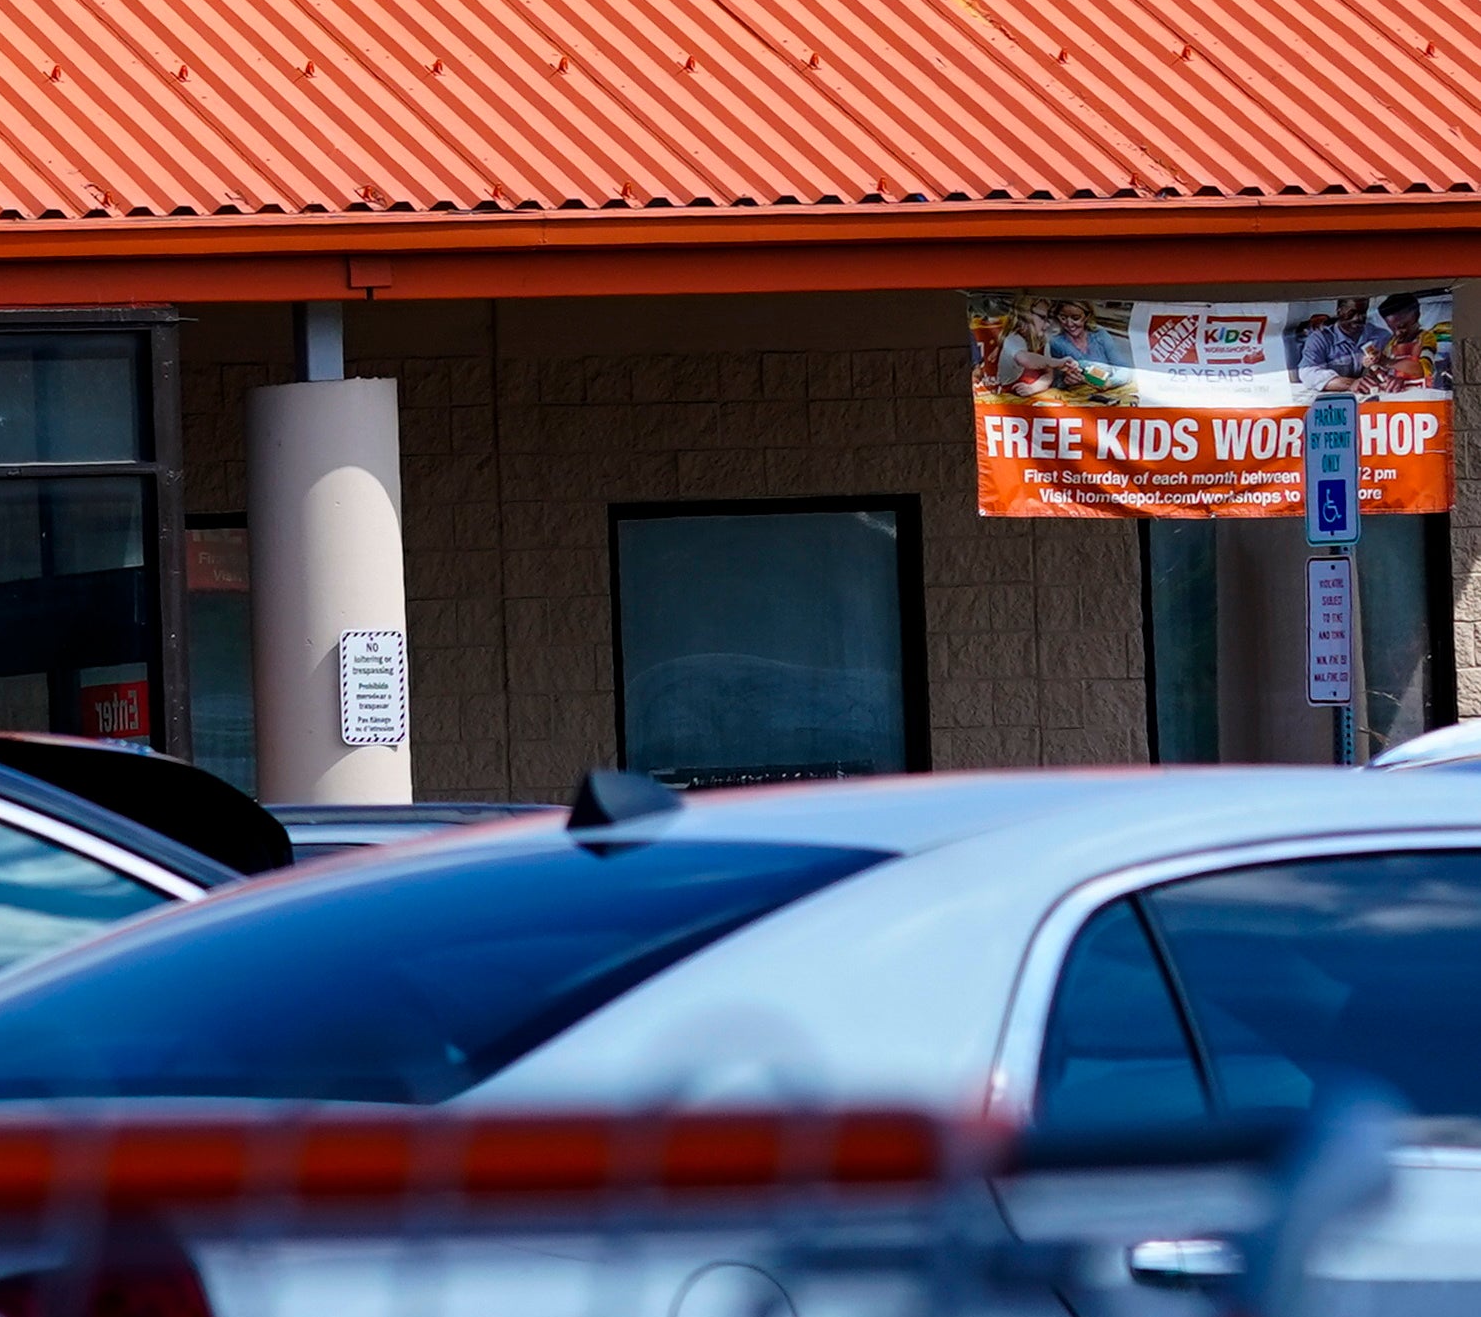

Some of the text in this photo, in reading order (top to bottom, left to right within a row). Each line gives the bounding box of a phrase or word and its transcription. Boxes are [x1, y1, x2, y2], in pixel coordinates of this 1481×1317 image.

[1150, 314, 1199, 363] HOME
[1152, 318, 1176, 340] THE
[1204, 327, 1254, 345] KIDS
[1169, 335, 1198, 364] DEPOT
[1167, 367, 1255, 383] 25 YEARS
[1314, 407, 1348, 427] PARKING
[984, 412, 1439, 462] FREE KIDS WORHOP
[1310, 431, 1351, 450] BY PERMIT
[1321, 454, 1341, 473] ONLY
[1023, 469, 1058, 484] First
[1062, 470, 1130, 488] Saturday
[1133, 471, 1151, 485] of
[1152, 470, 1187, 485] each
[1191, 470, 1238, 485] month
[1240, 470, 1301, 485] between
[1374, 469, 1397, 483] pm
[1039, 488, 1072, 503] Visit
[1075, 488, 1282, 508] homedepot.com/workshops
[1284, 489, 1301, 502] to
[366, 642, 379, 653] NO
